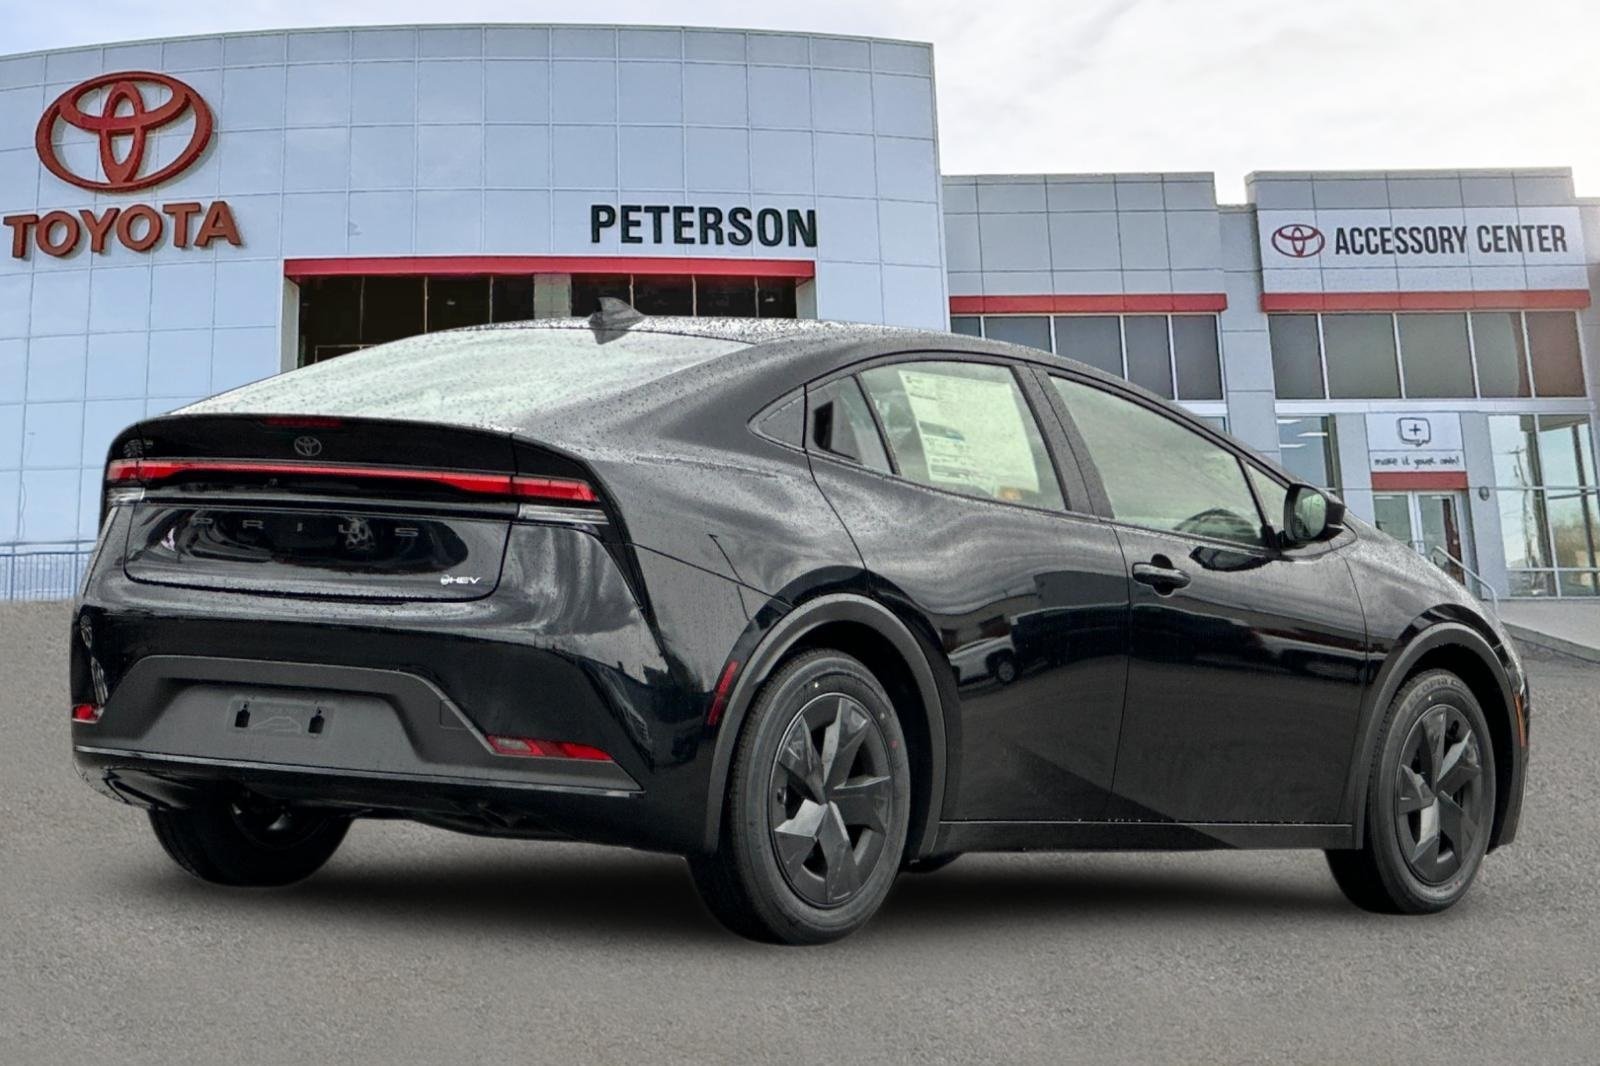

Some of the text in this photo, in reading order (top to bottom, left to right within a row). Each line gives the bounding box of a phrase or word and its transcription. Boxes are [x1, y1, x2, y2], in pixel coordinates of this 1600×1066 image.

[3, 200, 242, 258] TOYOTA
[590, 204, 818, 248] PETERSON
[1335, 224, 1568, 255] ACCESSORY CENTER
[194, 517, 419, 537] PRIUS
